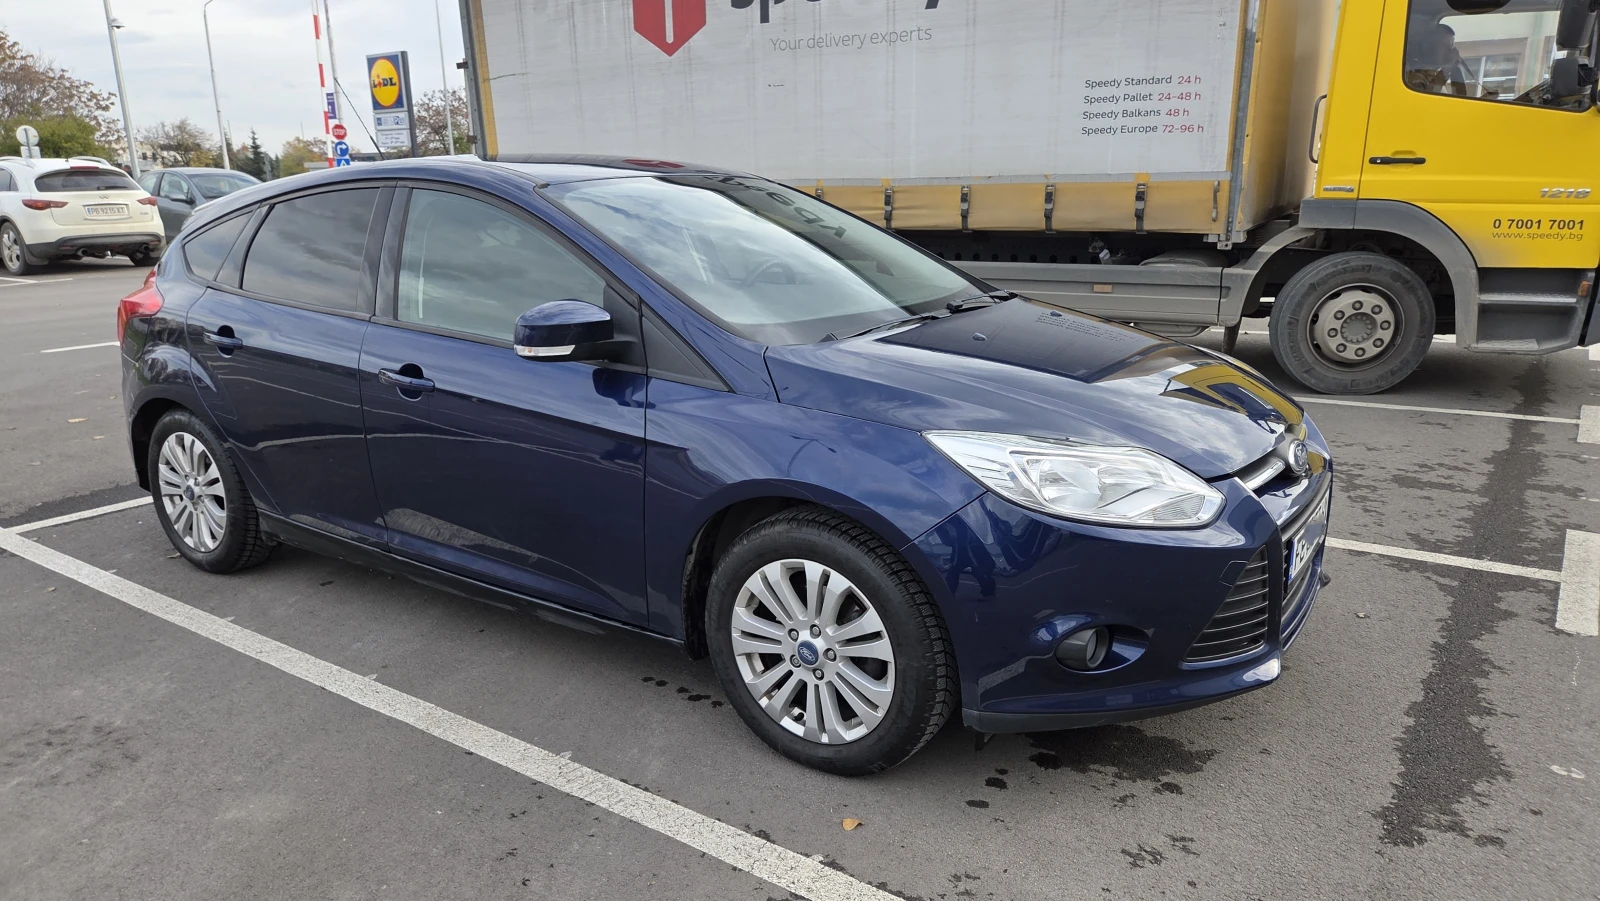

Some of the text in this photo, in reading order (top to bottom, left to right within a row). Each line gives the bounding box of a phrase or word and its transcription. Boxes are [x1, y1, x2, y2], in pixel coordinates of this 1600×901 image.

[770, 26, 933, 52] Your delivery experts
[1085, 75, 1202, 90] Speedy Standard 24 h
[1083, 91, 1202, 106] Speedy Pallet 24-48 h
[1082, 108, 1190, 121] Speedy Balkans 48 h
[333, 128, 346, 136] STOP
[1081, 124, 1205, 136] Speedy Europe 72-96 h
[1539, 187, 1592, 199] 1218
[1493, 218, 1585, 231] 0 7001 7001
[1492, 231, 1584, 242] www.speedy.bg
